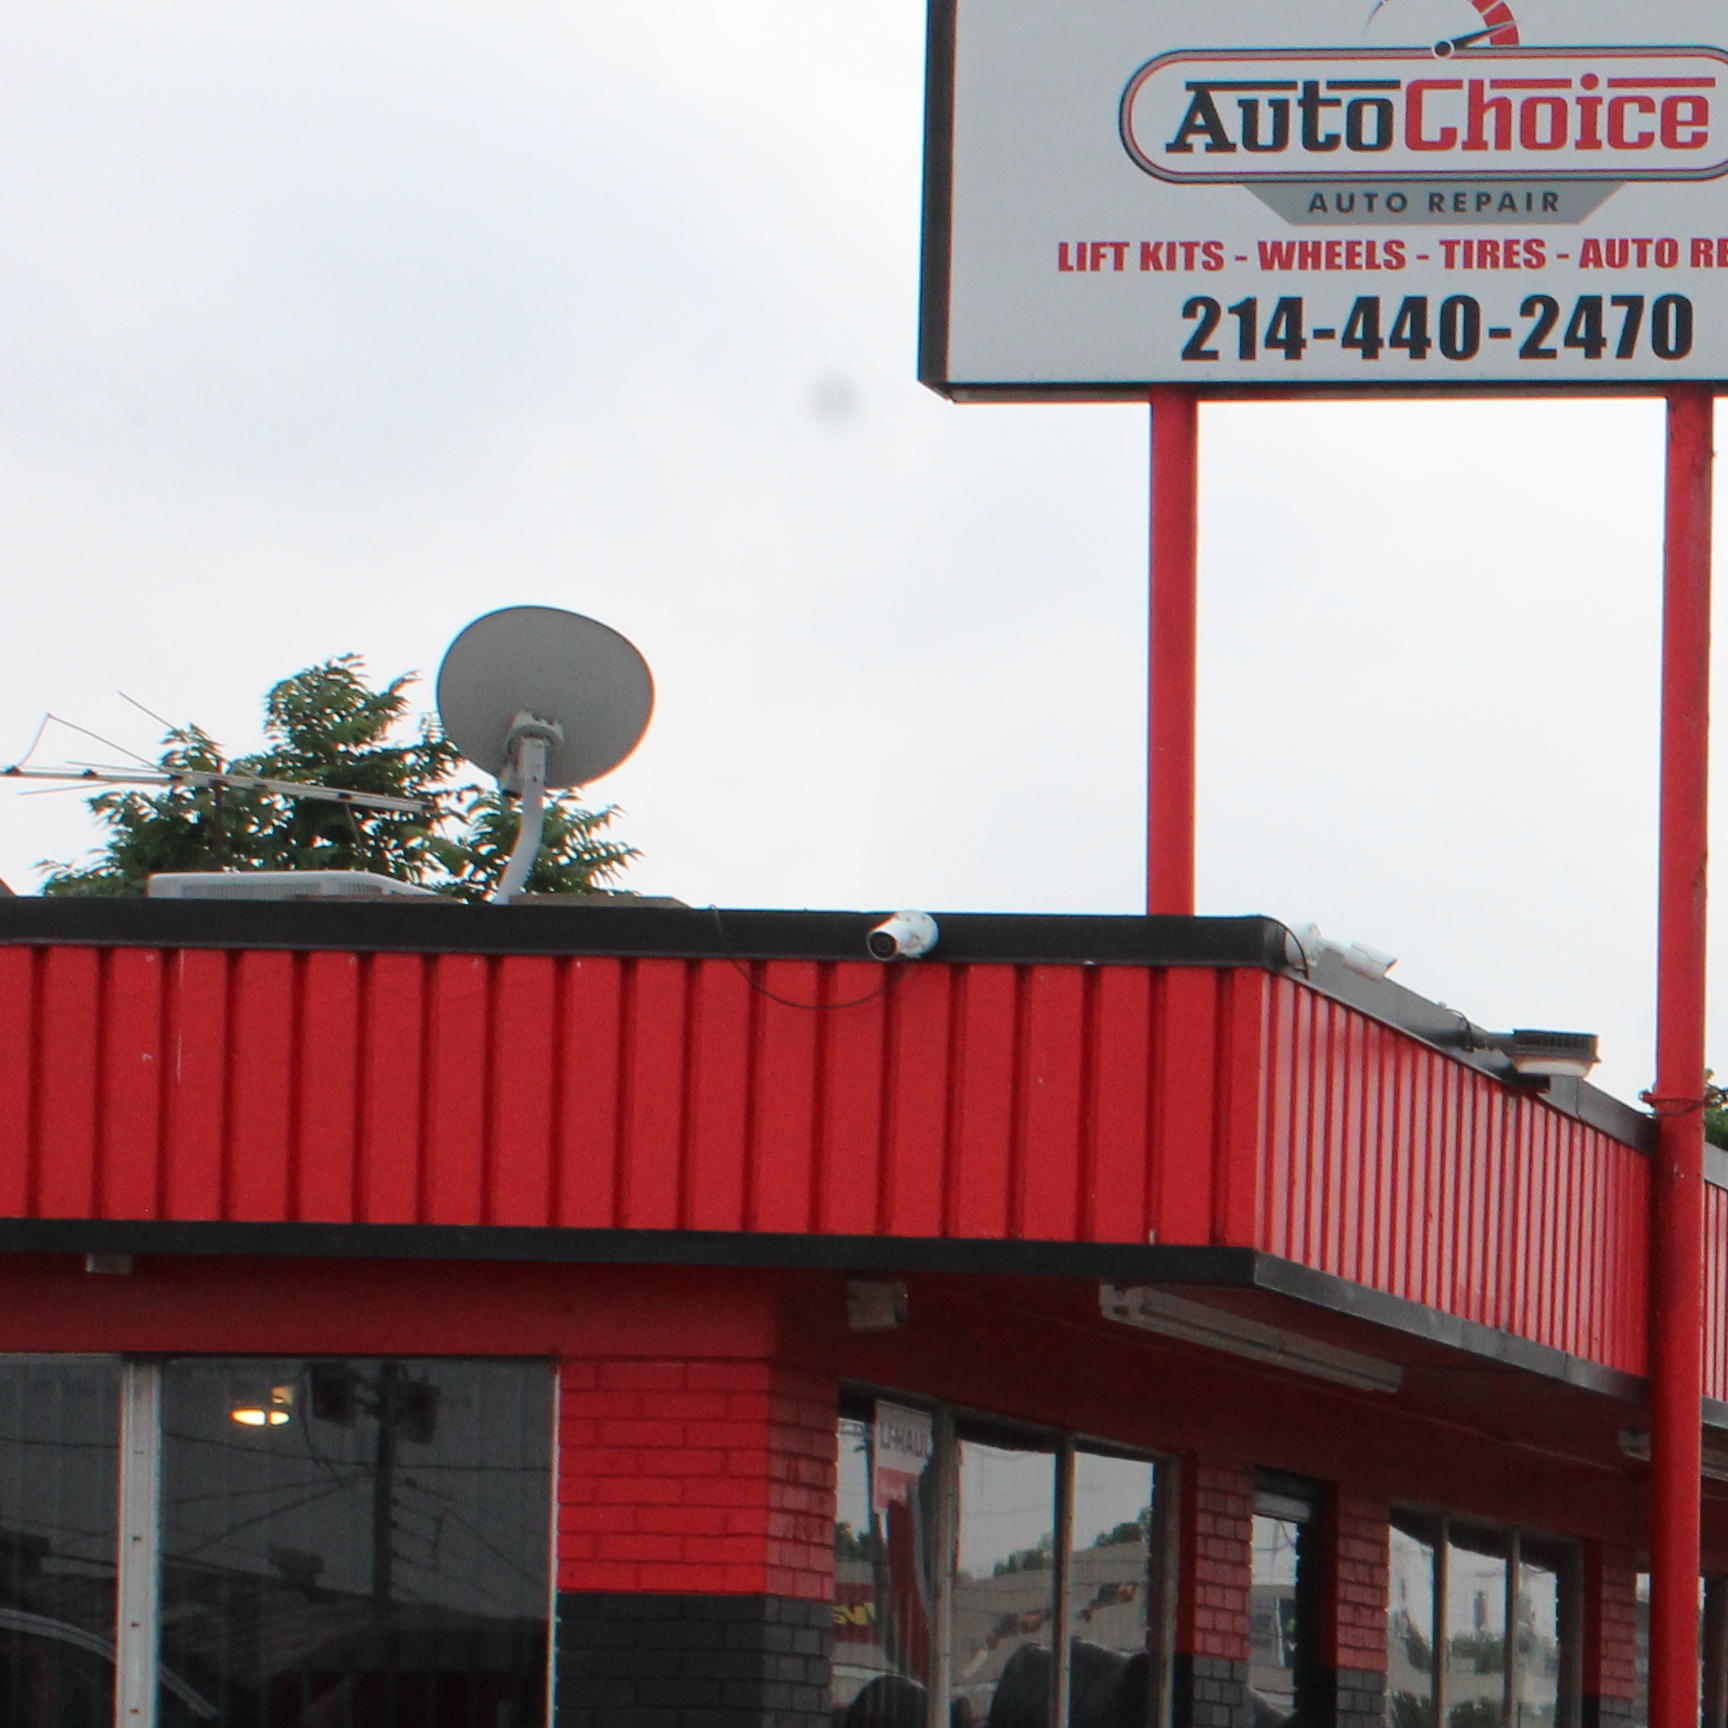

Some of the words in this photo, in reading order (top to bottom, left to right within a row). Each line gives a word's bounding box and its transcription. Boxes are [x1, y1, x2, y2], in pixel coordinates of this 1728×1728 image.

[1308, 192, 1408, 213] AUTO
[1428, 191, 1559, 212] REPAIR
[1058, 241, 1130, 272] LIFT
[1140, 240, 1225, 272] KITS
[1257, 240, 1406, 271] WHEELS
[1439, 239, 1546, 269] TIRES
[1579, 238, 1679, 268] AUTO
[1181, 295, 1694, 361] 214-440-2470
